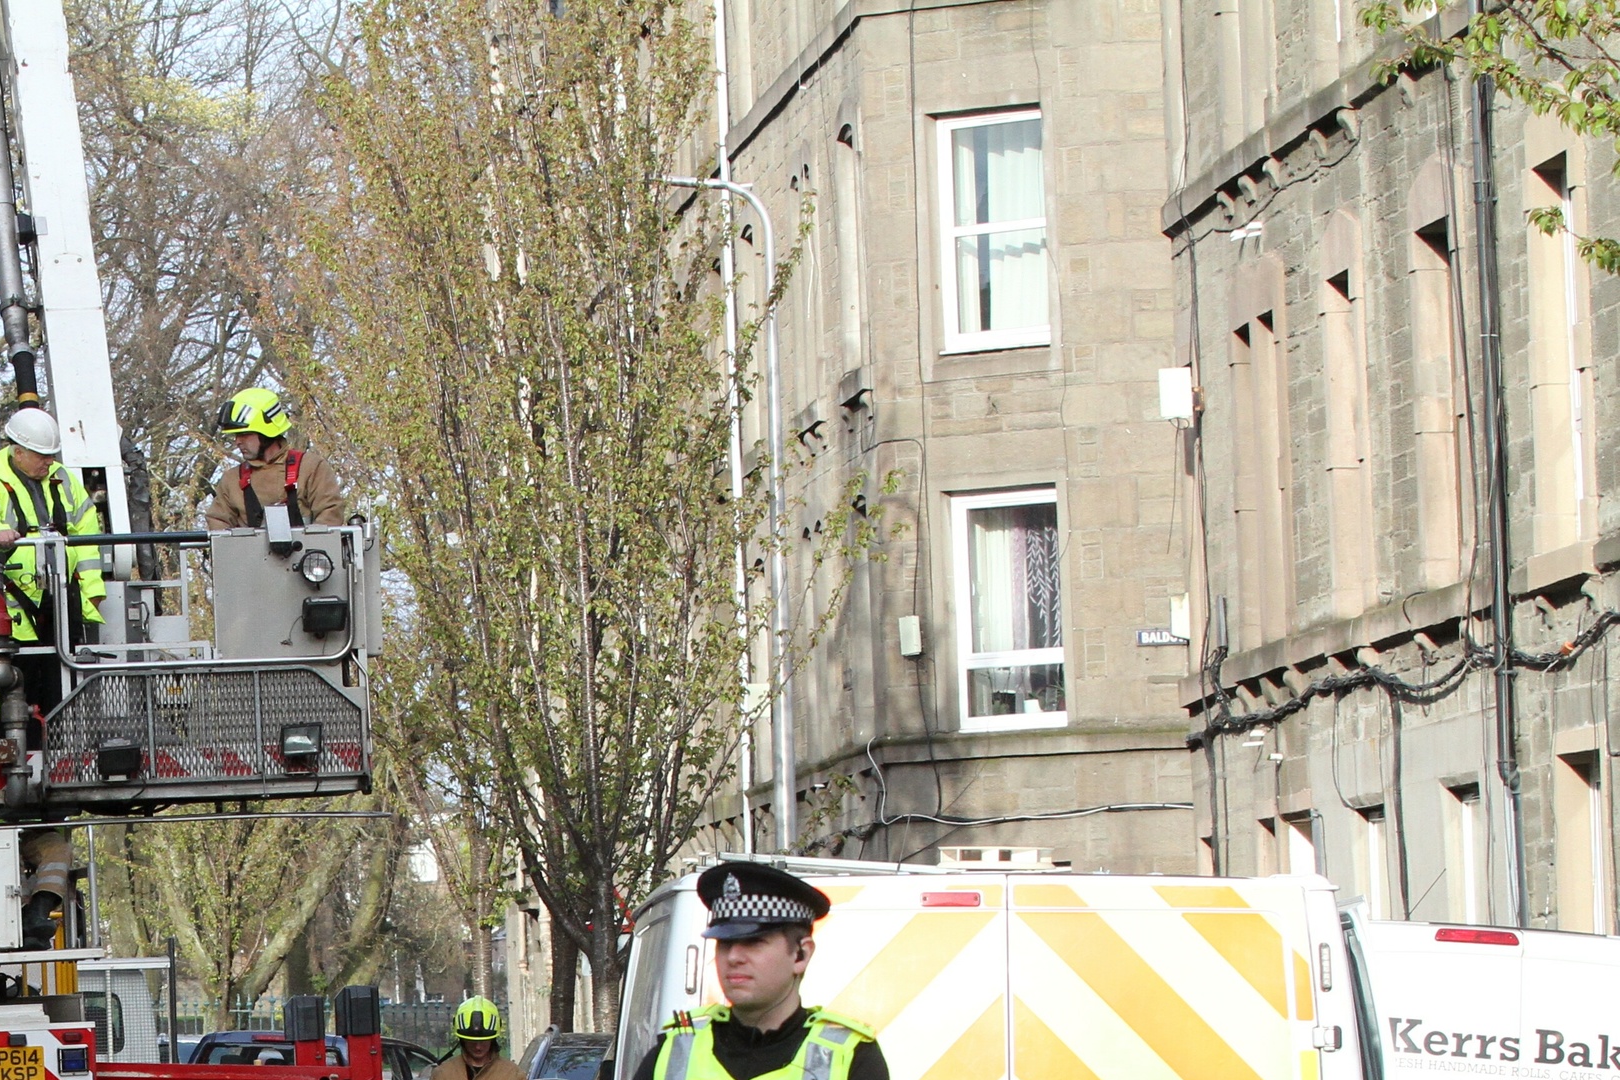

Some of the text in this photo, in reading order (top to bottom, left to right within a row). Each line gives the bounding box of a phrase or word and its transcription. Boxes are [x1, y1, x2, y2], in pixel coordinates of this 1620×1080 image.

[1388, 1017, 1620, 1071] Kerrs Bak
[1428, 1060, 1506, 1077] HANDMADE
